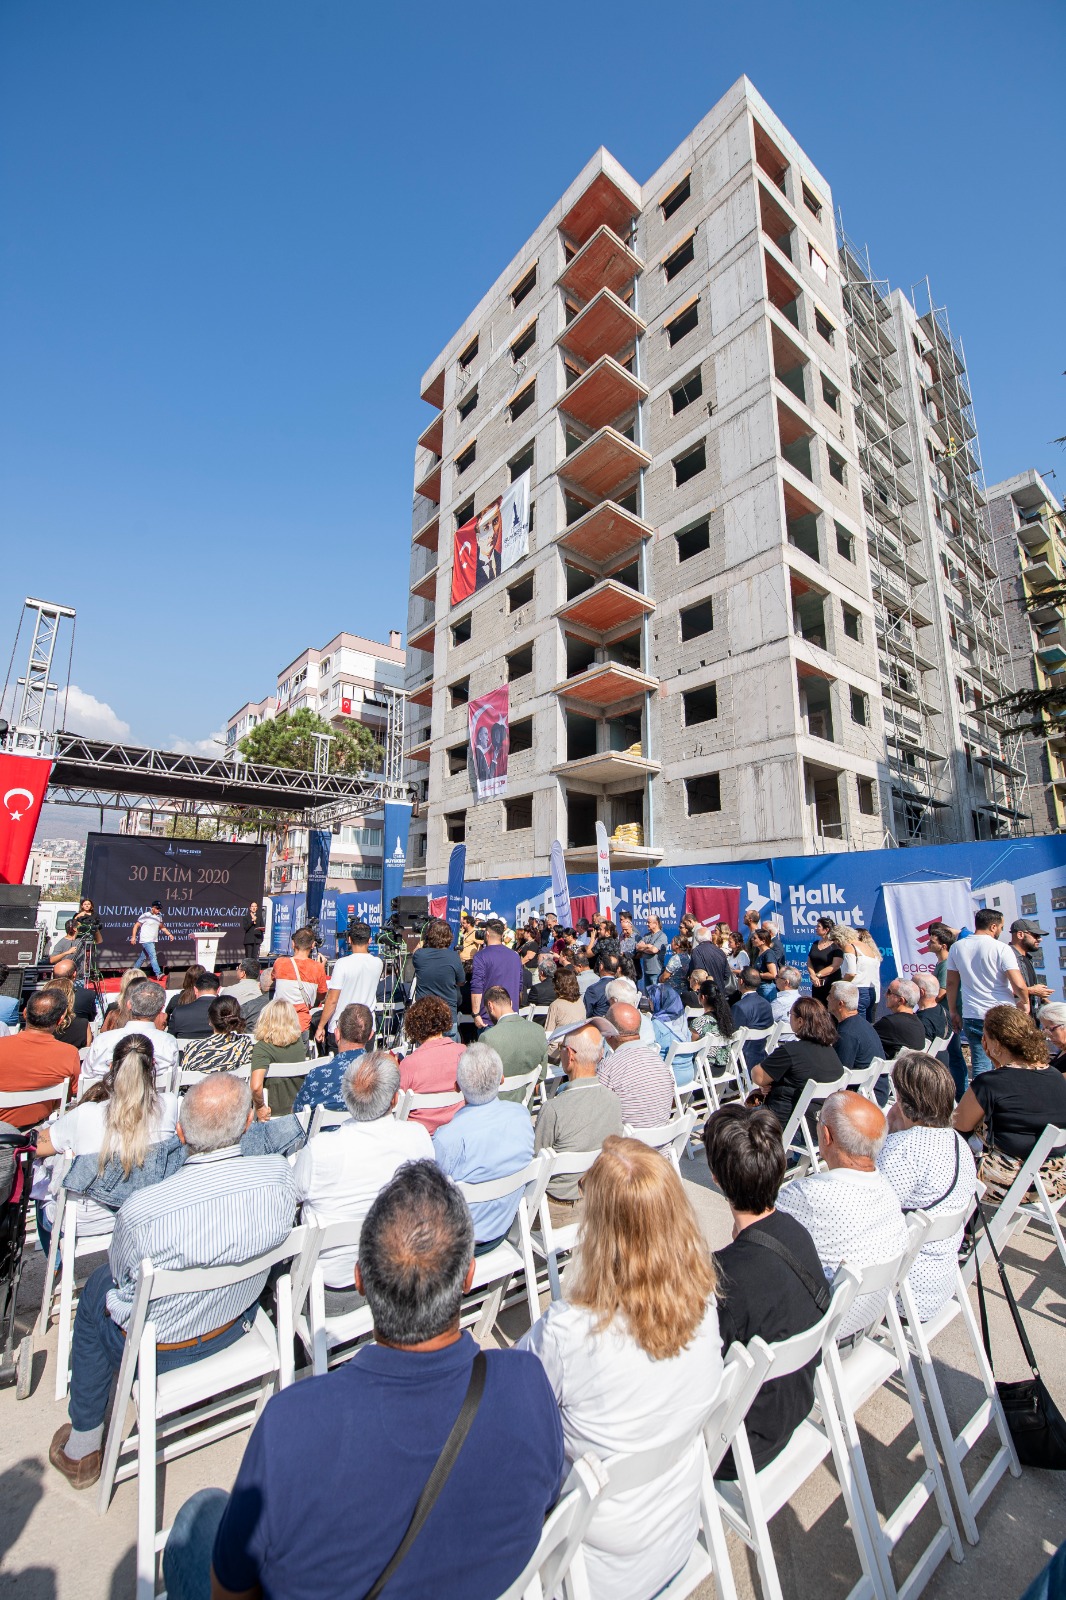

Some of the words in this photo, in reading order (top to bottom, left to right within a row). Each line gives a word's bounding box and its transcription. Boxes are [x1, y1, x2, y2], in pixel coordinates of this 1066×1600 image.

[128, 865, 148, 881] 30
[153, 864, 191, 882] EKİM
[197, 868, 230, 884] 2020
[165, 888, 193, 901] 14.51
[632, 886, 666, 903] Halk
[789, 883, 846, 905] Halk
[98, 905, 165, 917] UNUTMAD,
[368, 903, 380, 914] Hal
[471, 898, 491, 911] Halk
[633, 902, 677, 920] Konut
[368, 913, 381, 924] Kon
[790, 904, 865, 926] Konut
[783, 943, 807, 954] E'YE
